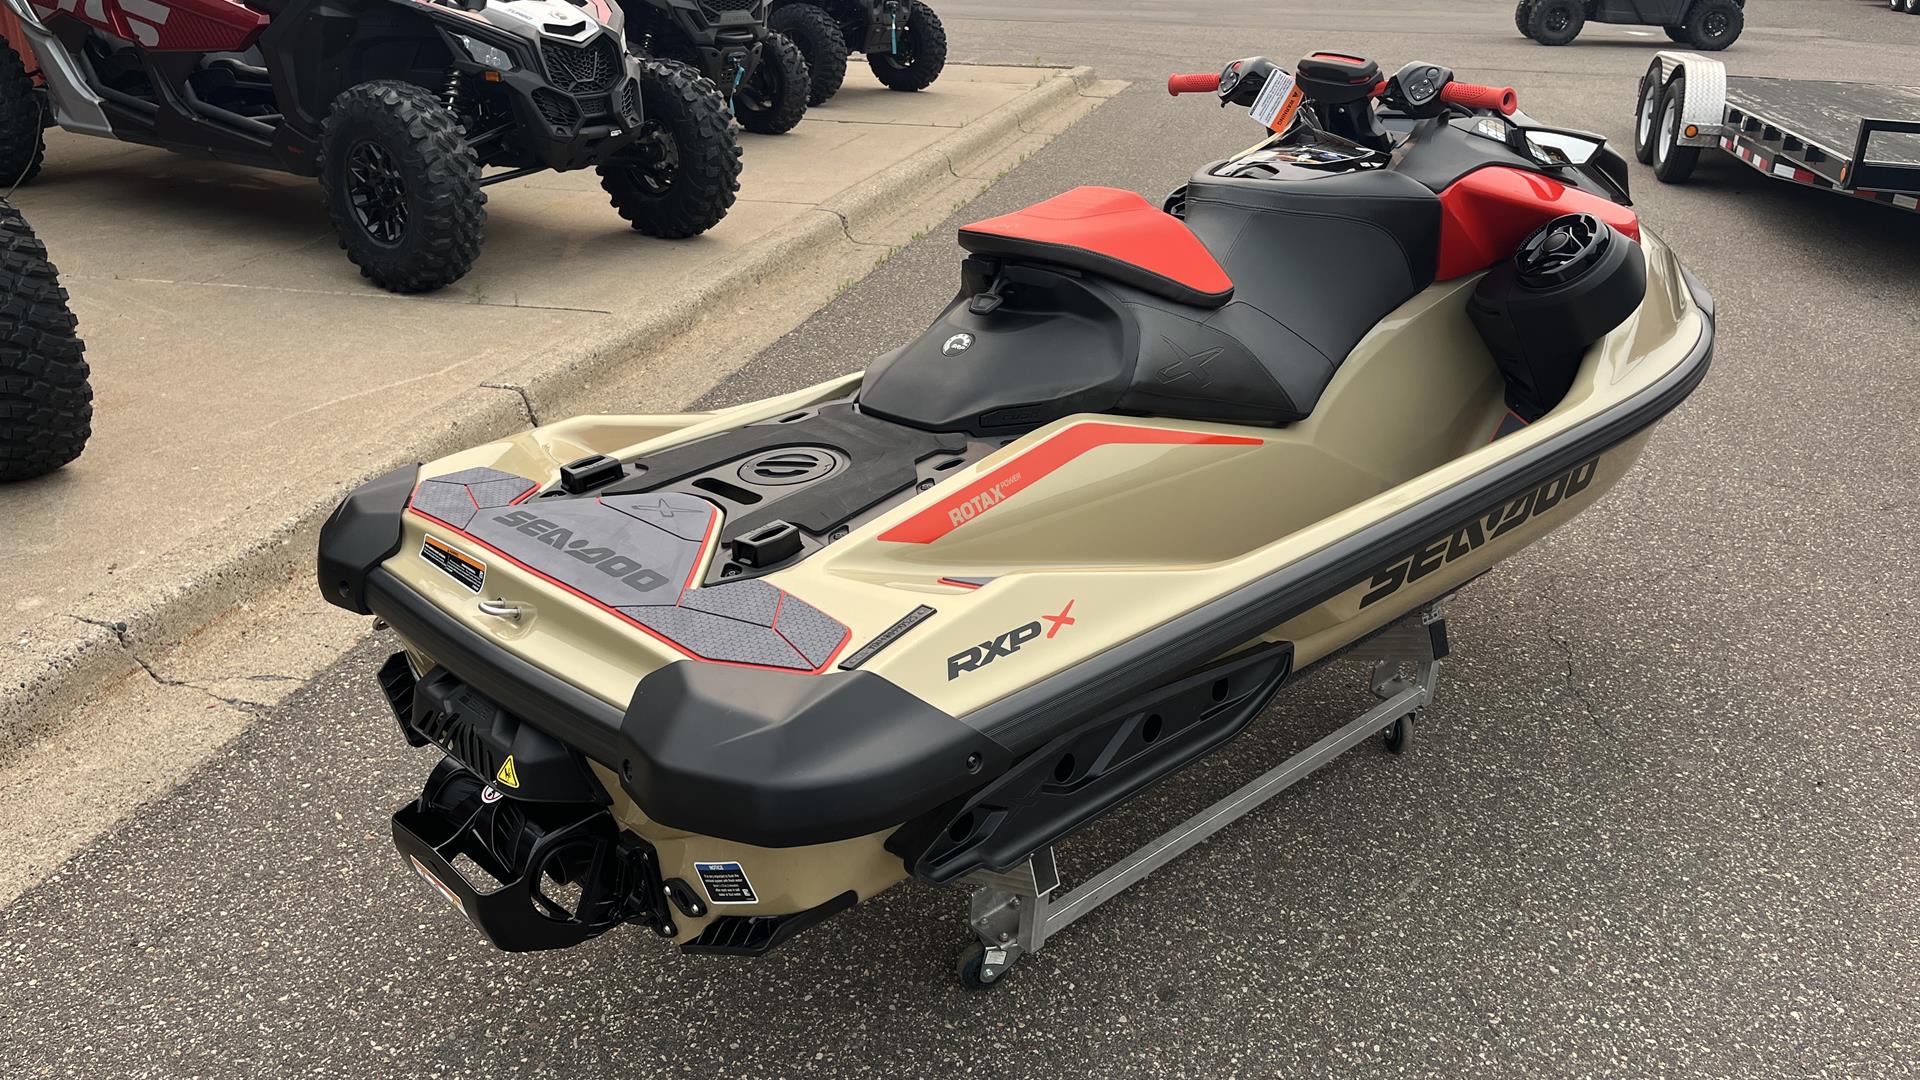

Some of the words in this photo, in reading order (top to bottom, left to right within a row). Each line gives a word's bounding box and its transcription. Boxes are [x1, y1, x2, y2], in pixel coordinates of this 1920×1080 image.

[1277, 99, 1294, 126] WARNING
[948, 483, 1006, 527] ROTAX
[1000, 471, 1022, 489] POWER
[947, 620, 1042, 682] RXP
